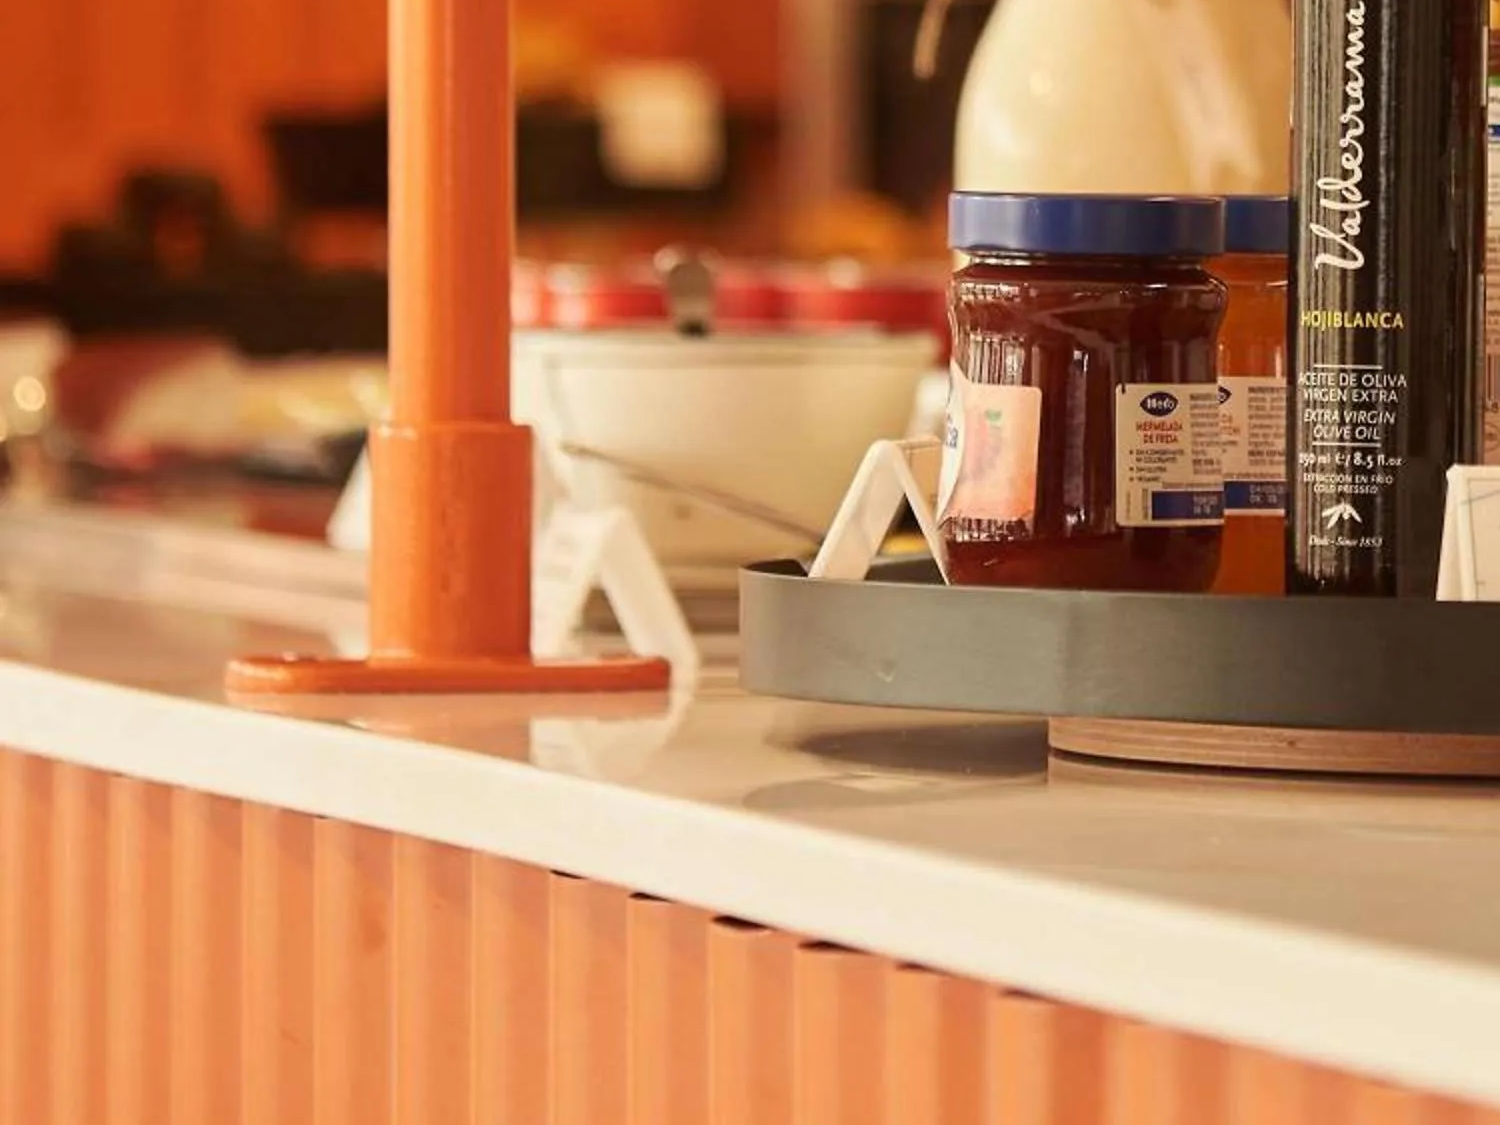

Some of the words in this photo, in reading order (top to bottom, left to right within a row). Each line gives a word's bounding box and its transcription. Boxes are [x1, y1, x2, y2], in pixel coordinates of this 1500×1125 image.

[1309, 0, 1371, 270] Valderrama
[1301, 310, 1404, 331] HOJIBLANCA
[1298, 372, 1336, 386] ACEITE
[1339, 373, 1357, 387] DE
[1361, 374, 1408, 388] OLIVA
[1303, 387, 1347, 402] VIRGEN
[1352, 389, 1399, 403] EXTRA
[1303, 408, 1340, 423] EXTRA
[1343, 410, 1397, 424] VIRGIN
[1313, 424, 1351, 438] OLIVE
[1355, 426, 1382, 440] OIL
[1353, 451, 1375, 469] 8.5
